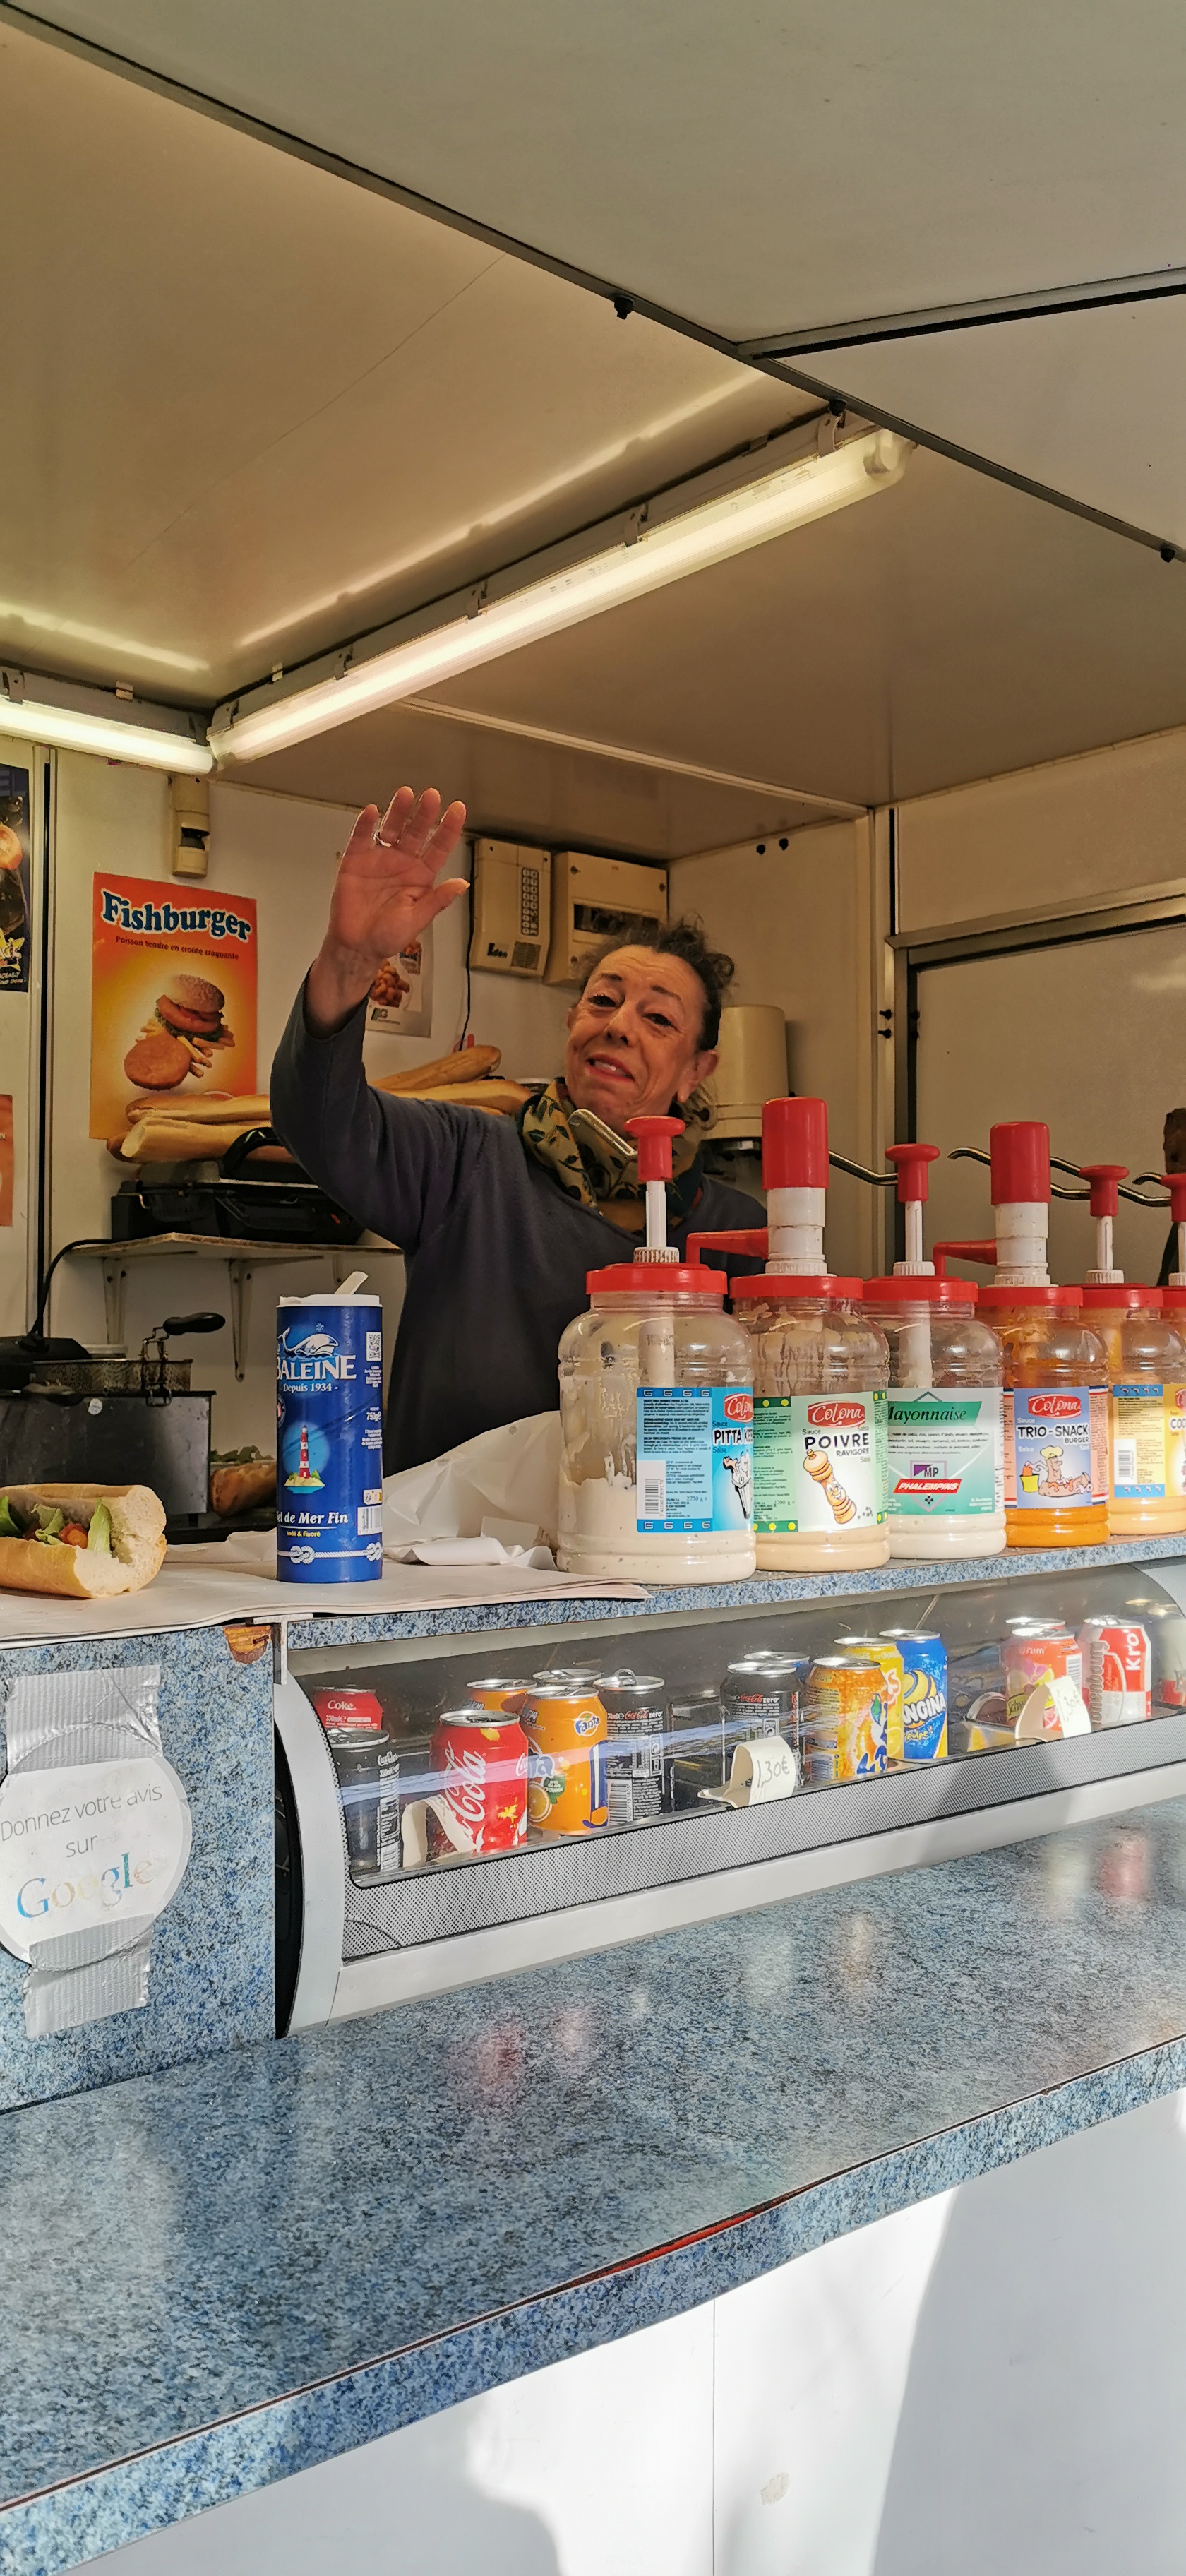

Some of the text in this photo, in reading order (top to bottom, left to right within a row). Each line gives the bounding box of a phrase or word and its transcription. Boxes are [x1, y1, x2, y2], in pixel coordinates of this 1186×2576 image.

[102, 890, 251, 941] Fishburger
[116, 936, 143, 946] Poisson
[145, 941, 169, 950] tendre
[205, 949, 239, 960] croquante
[283, 1383, 332, 1394] Depuis 1934
[812, 1403, 865, 1424] Colona
[1031, 1396, 1081, 1414] Colona
[714, 1429, 742, 1445] PITTA
[804, 1432, 870, 1450] POIVRE
[836, 1448, 870, 1457] RAVIGORE
[923, 1467, 939, 1478] MP
[897, 1482, 959, 1491] PHALEMPINS
[284, 1511, 296, 1523] de
[298, 1512, 325, 1524] Mer
[327, 1512, 349, 1524] Fin
[327, 1700, 357, 1711] Coke
[648, 1710, 664, 1719] zero
[573, 1715, 601, 1736] Fanta
[0, 1783, 163, 1842] Donnez votre avis
[66, 1835, 98, 1858] sur
[16, 1852, 155, 1919] Google
